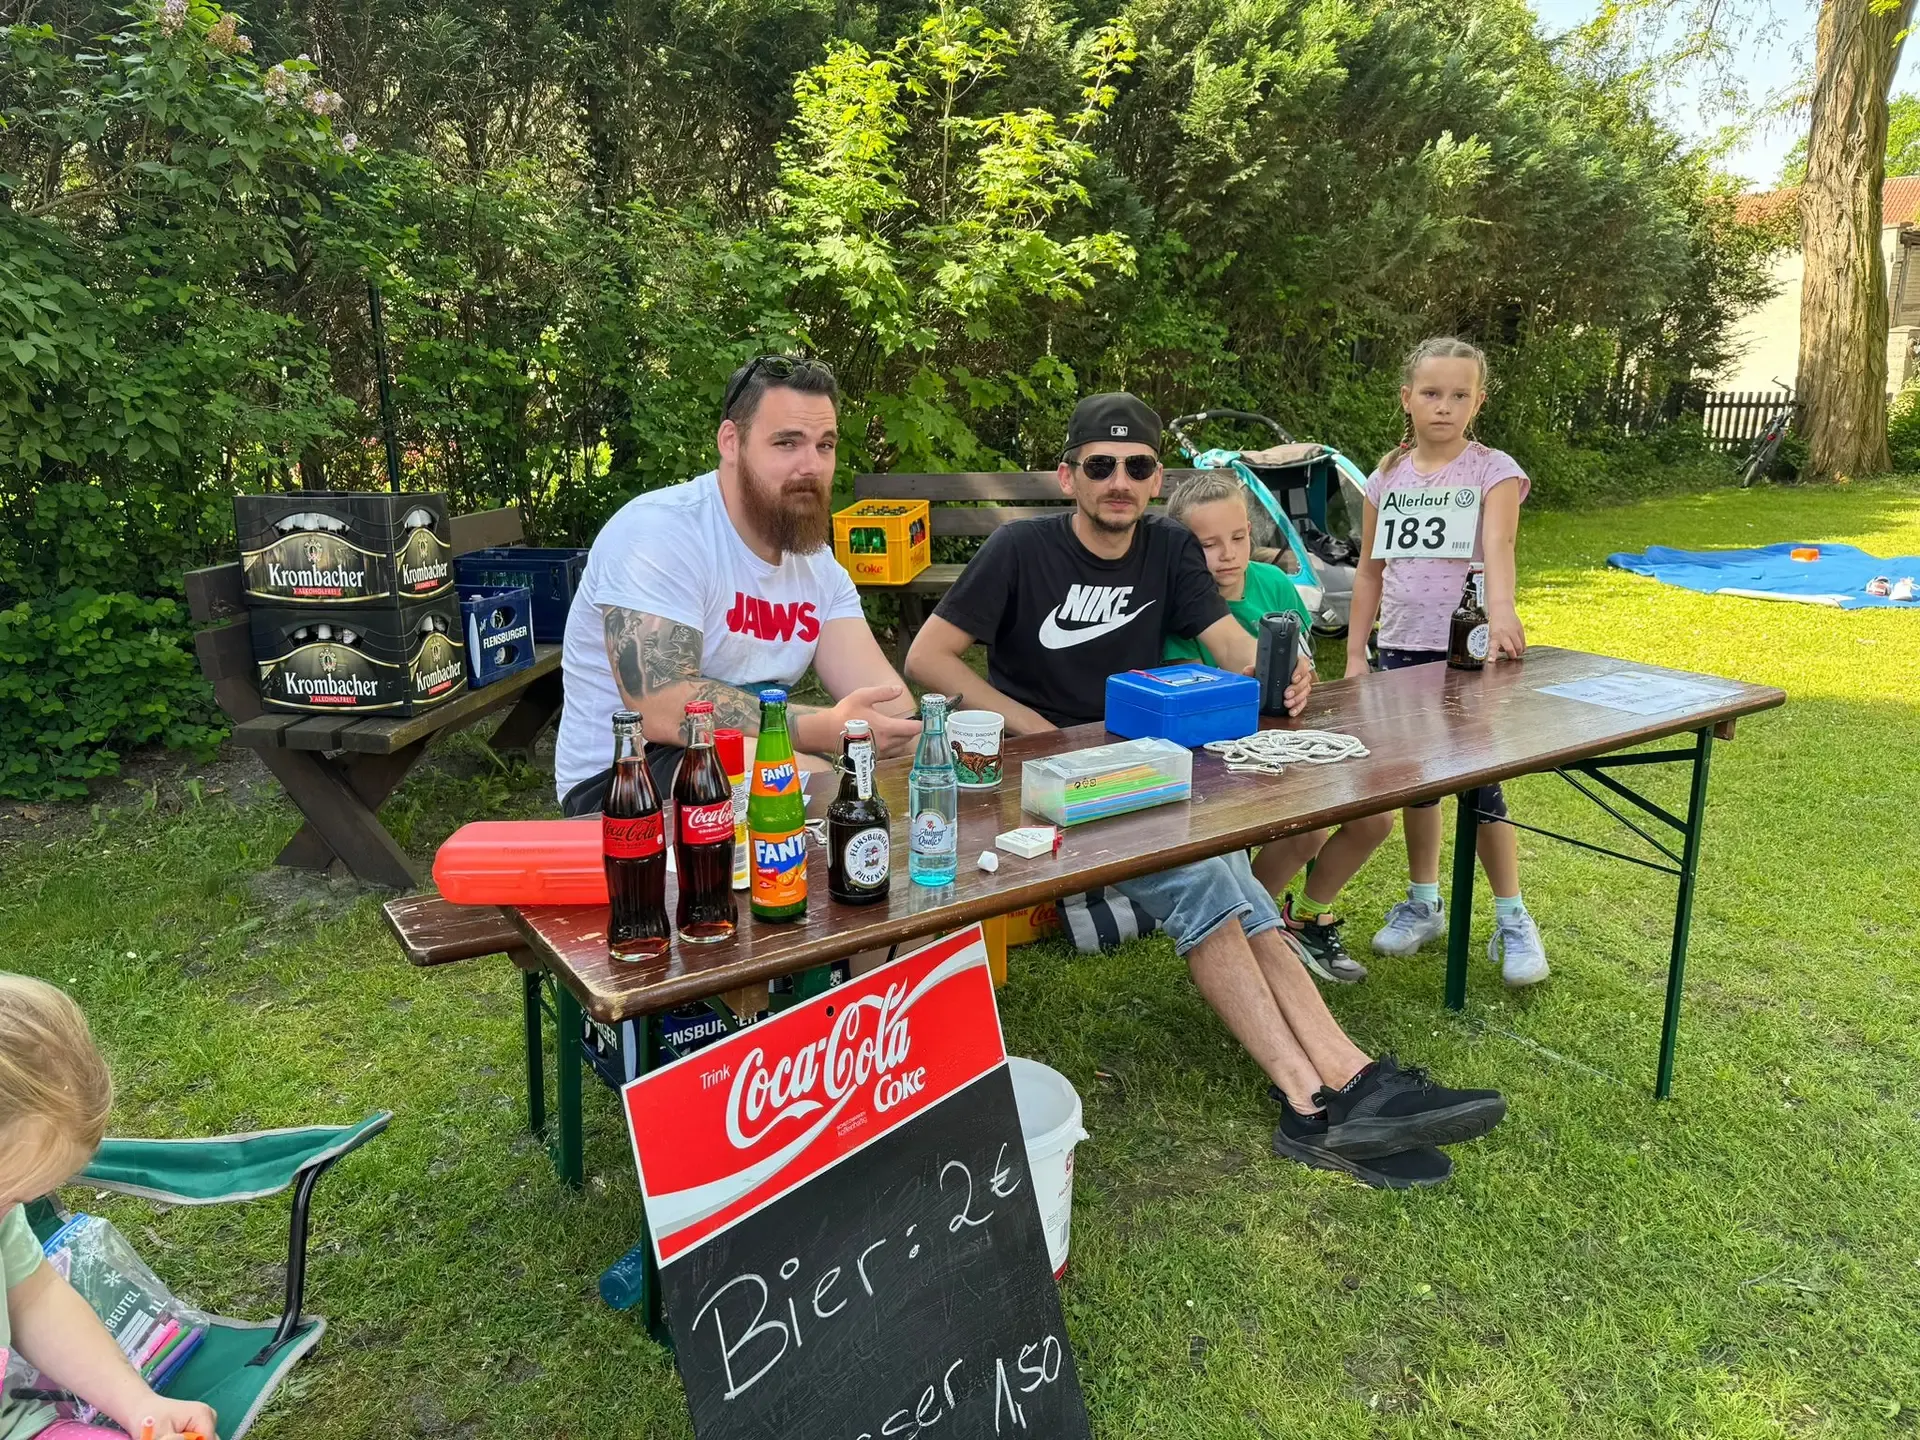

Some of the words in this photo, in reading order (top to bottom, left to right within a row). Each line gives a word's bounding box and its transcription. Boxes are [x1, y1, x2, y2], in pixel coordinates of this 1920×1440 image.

[1383, 491, 1450, 515] Allerlauf
[1384, 516, 1446, 550] 183
[268, 563, 365, 587] Krombacher
[403, 561, 448, 585] Krombacher
[856, 562, 883, 574] Coke
[1057, 584, 1134, 623] NIKE
[726, 591, 820, 643] JAWS
[483, 625, 527, 649] FLENSBURGER
[285, 672, 378, 697] Krombacher
[416, 660, 462, 692] Krombacher
[849, 832, 888, 857] FLENSBURGER
[854, 864, 887, 883] PILSENER
[700, 1064, 731, 1090] Trink
[725, 978, 911, 1149] Coca-Cola
[873, 1066, 926, 1112] Coke
[149, 1300, 169, 1315] 1L
[995, 1335, 1062, 1437] 1,50
